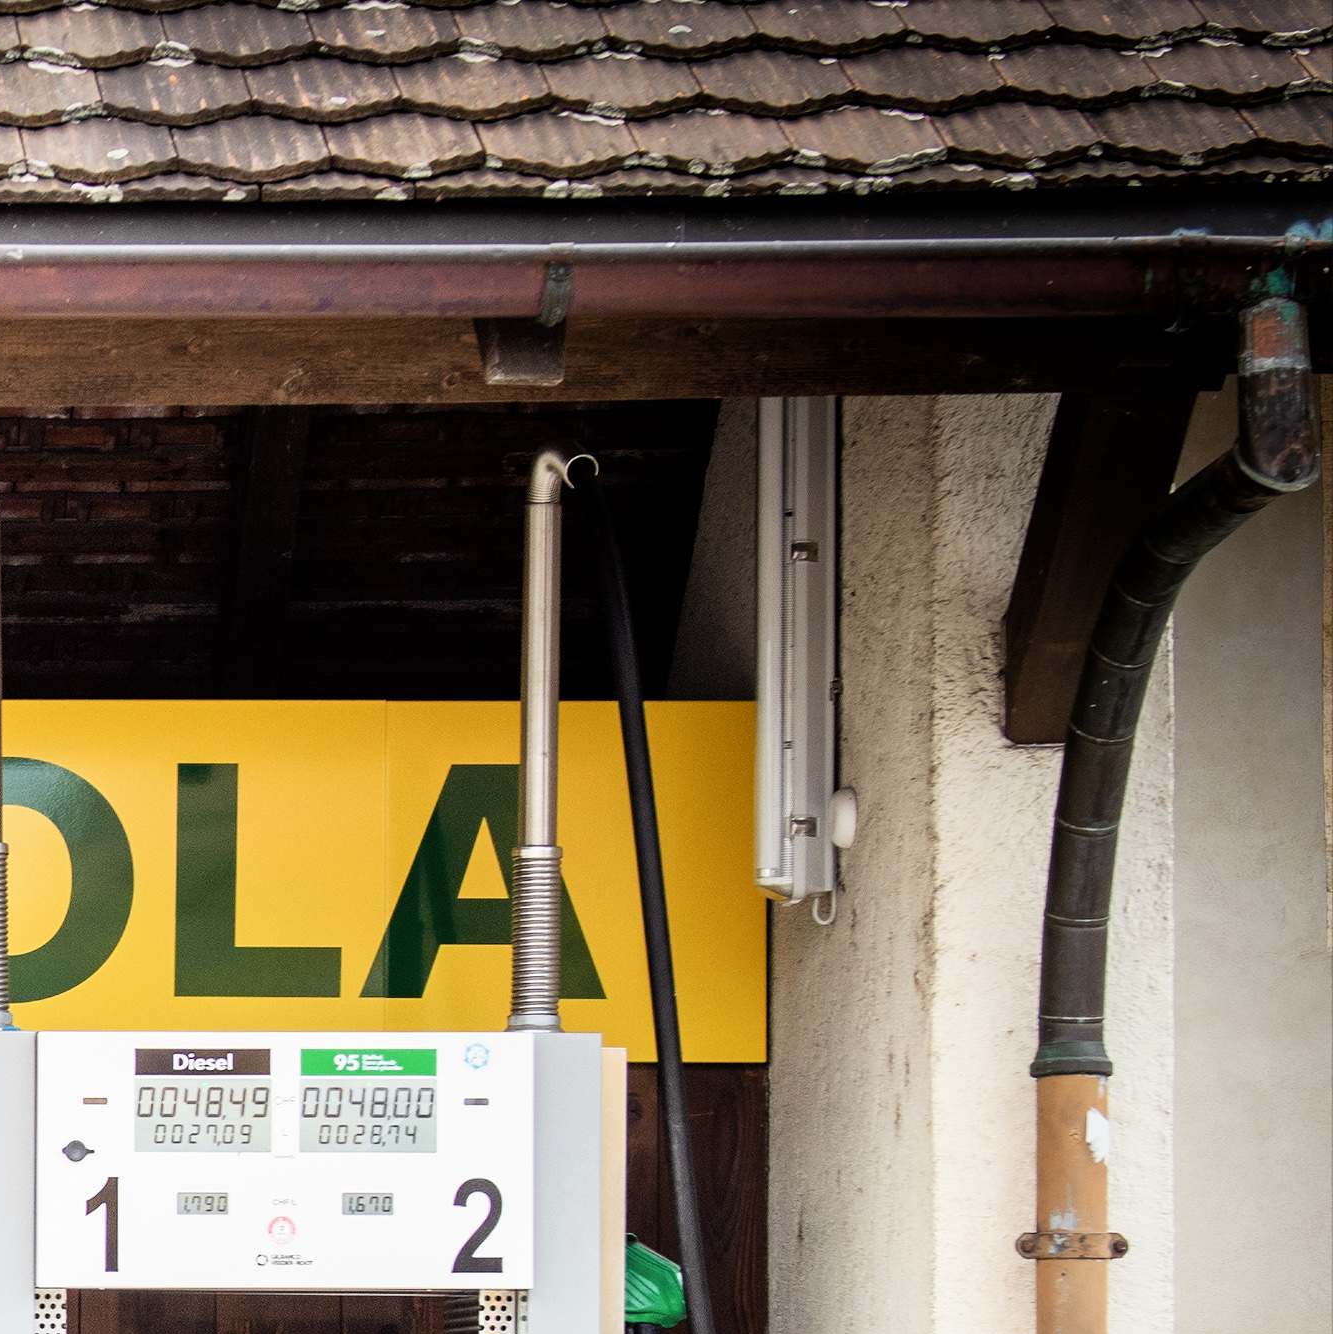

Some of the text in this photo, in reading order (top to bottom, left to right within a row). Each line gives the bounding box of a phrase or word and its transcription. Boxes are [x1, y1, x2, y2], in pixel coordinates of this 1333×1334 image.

[172, 1053, 234, 1071] Diesel
[333, 1053, 360, 1072] 95
[136, 1086, 269, 1120] 0048,49
[301, 1086, 434, 1121] 0048,00
[153, 1124, 252, 1147] 0027,09
[318, 1124, 418, 1147] 0028,74
[85, 1176, 119, 1273] 1
[451, 1177, 504, 1273] 2
